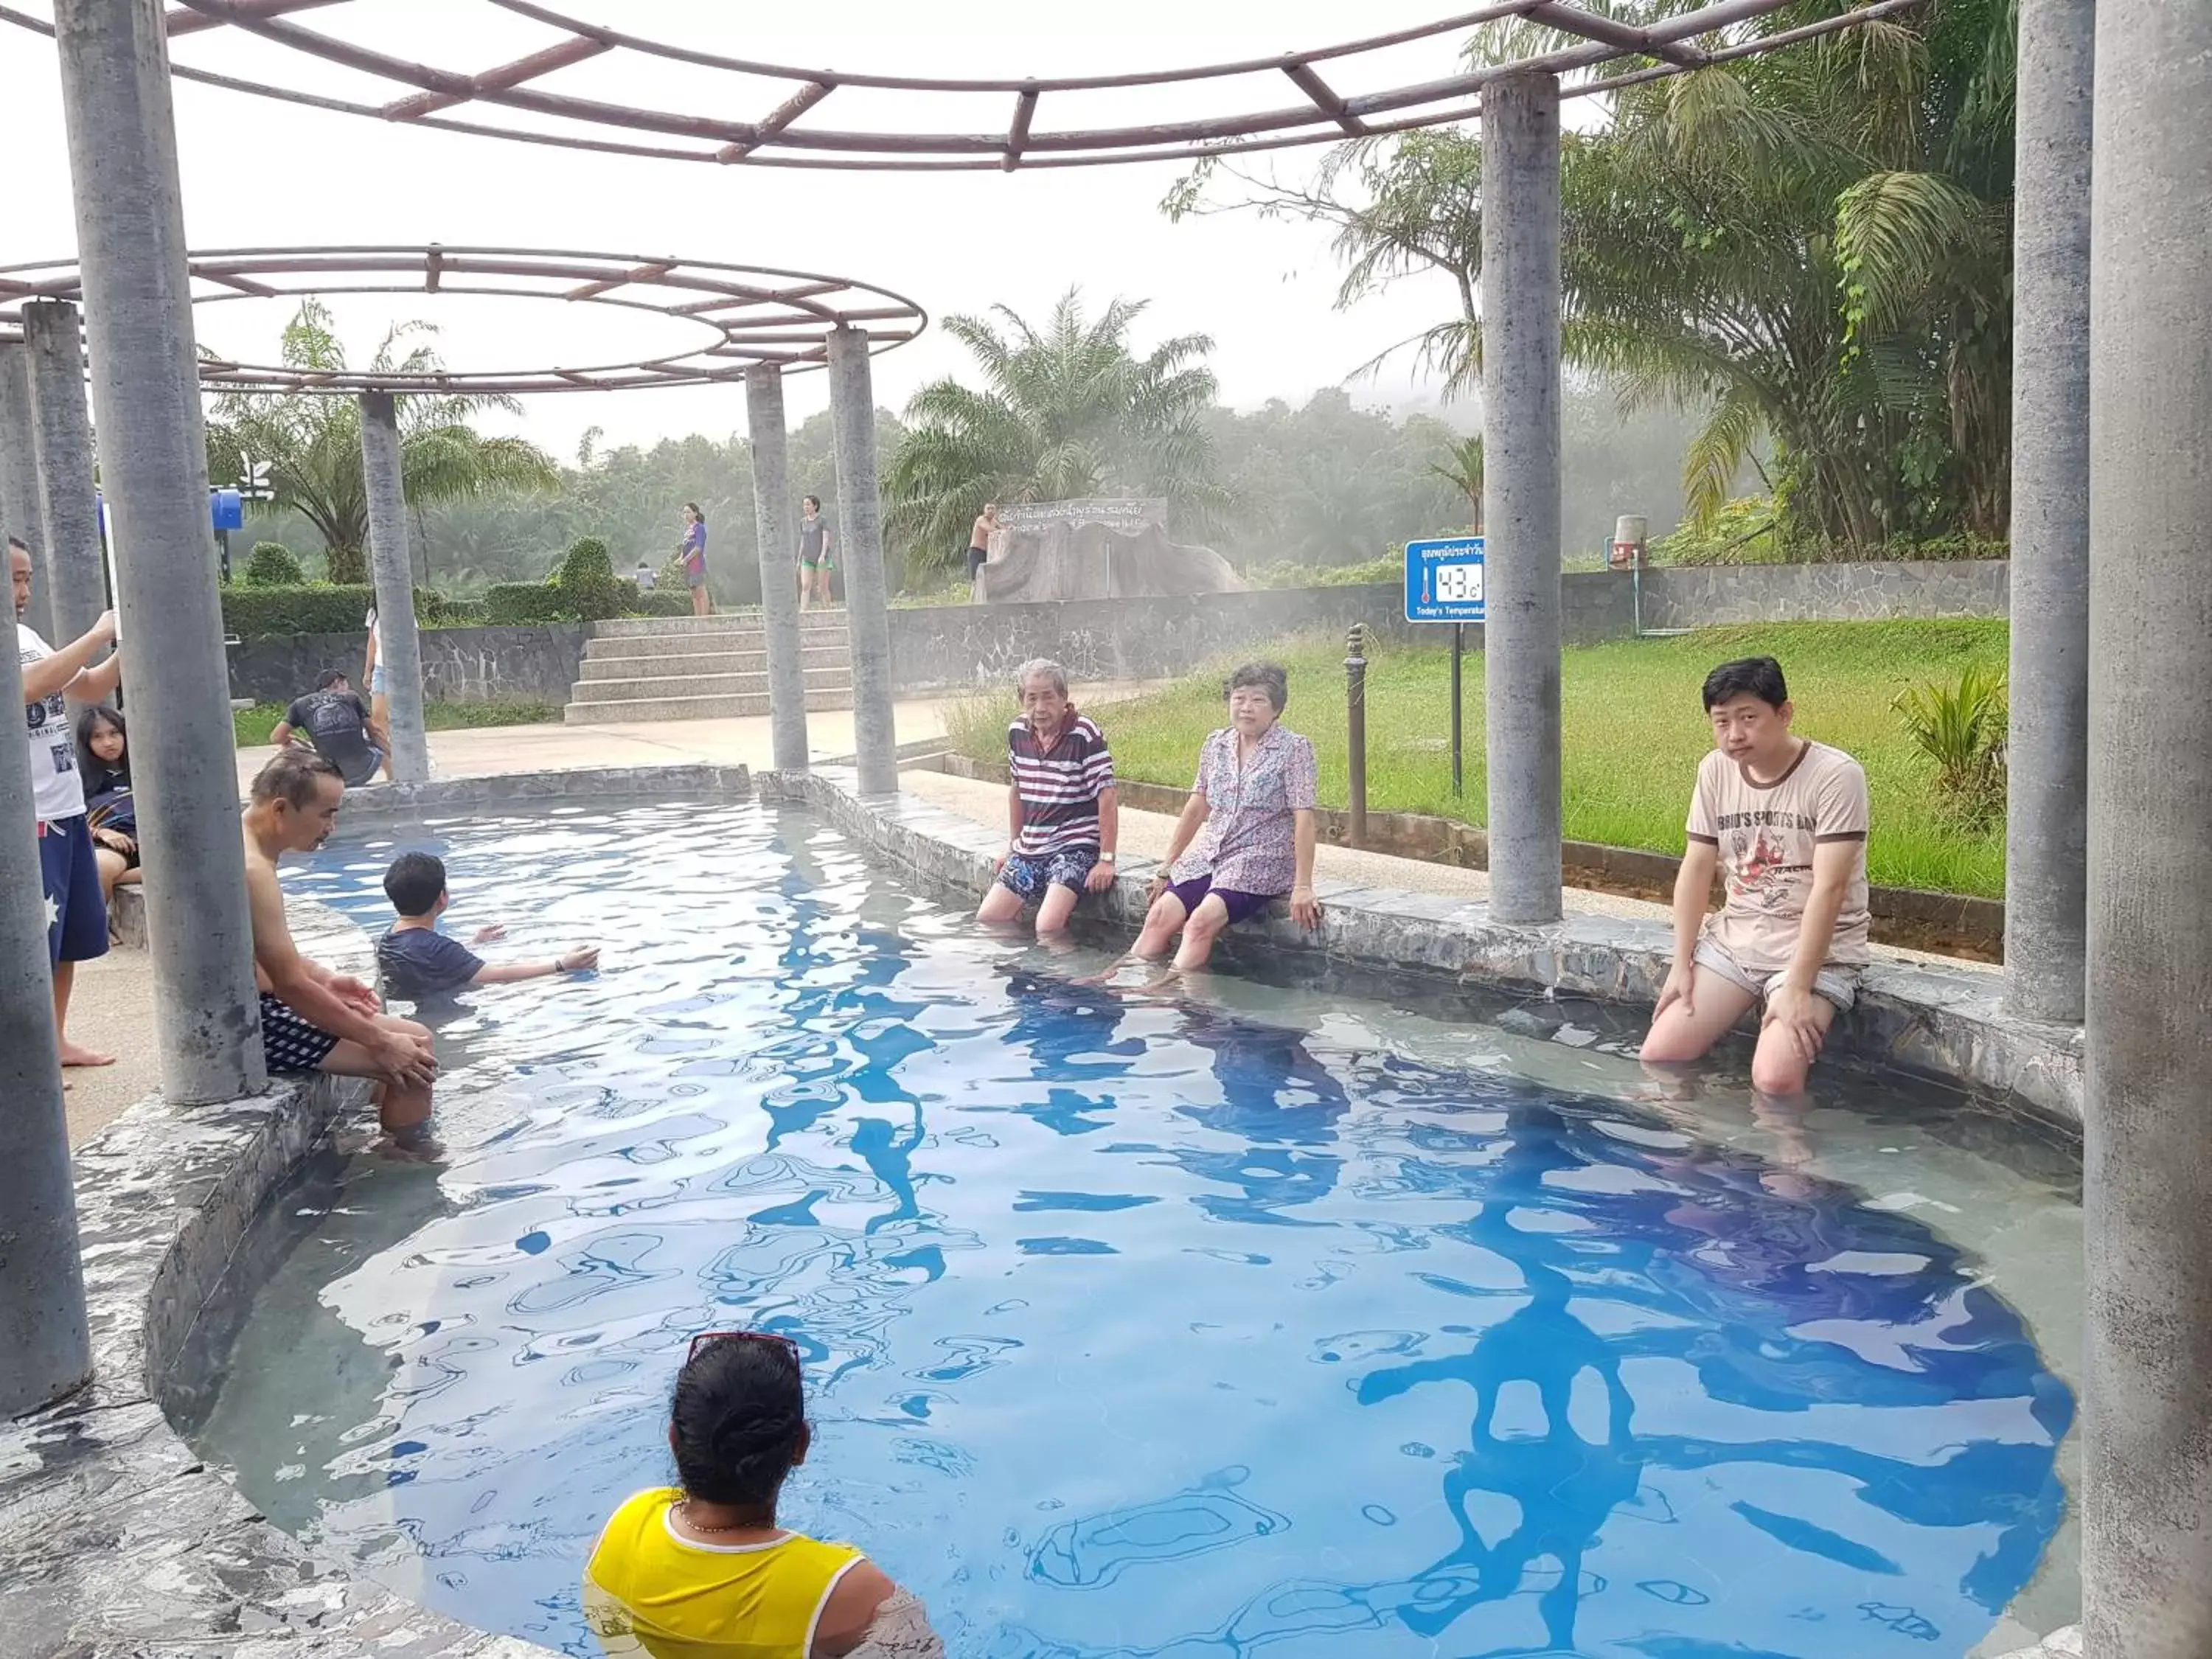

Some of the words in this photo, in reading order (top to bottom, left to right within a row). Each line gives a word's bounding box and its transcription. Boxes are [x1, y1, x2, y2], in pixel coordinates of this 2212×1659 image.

[1439, 568, 1467, 598] 43
[1416, 606, 1443, 617] Today's
[1444, 605, 1484, 617] Temperatur
